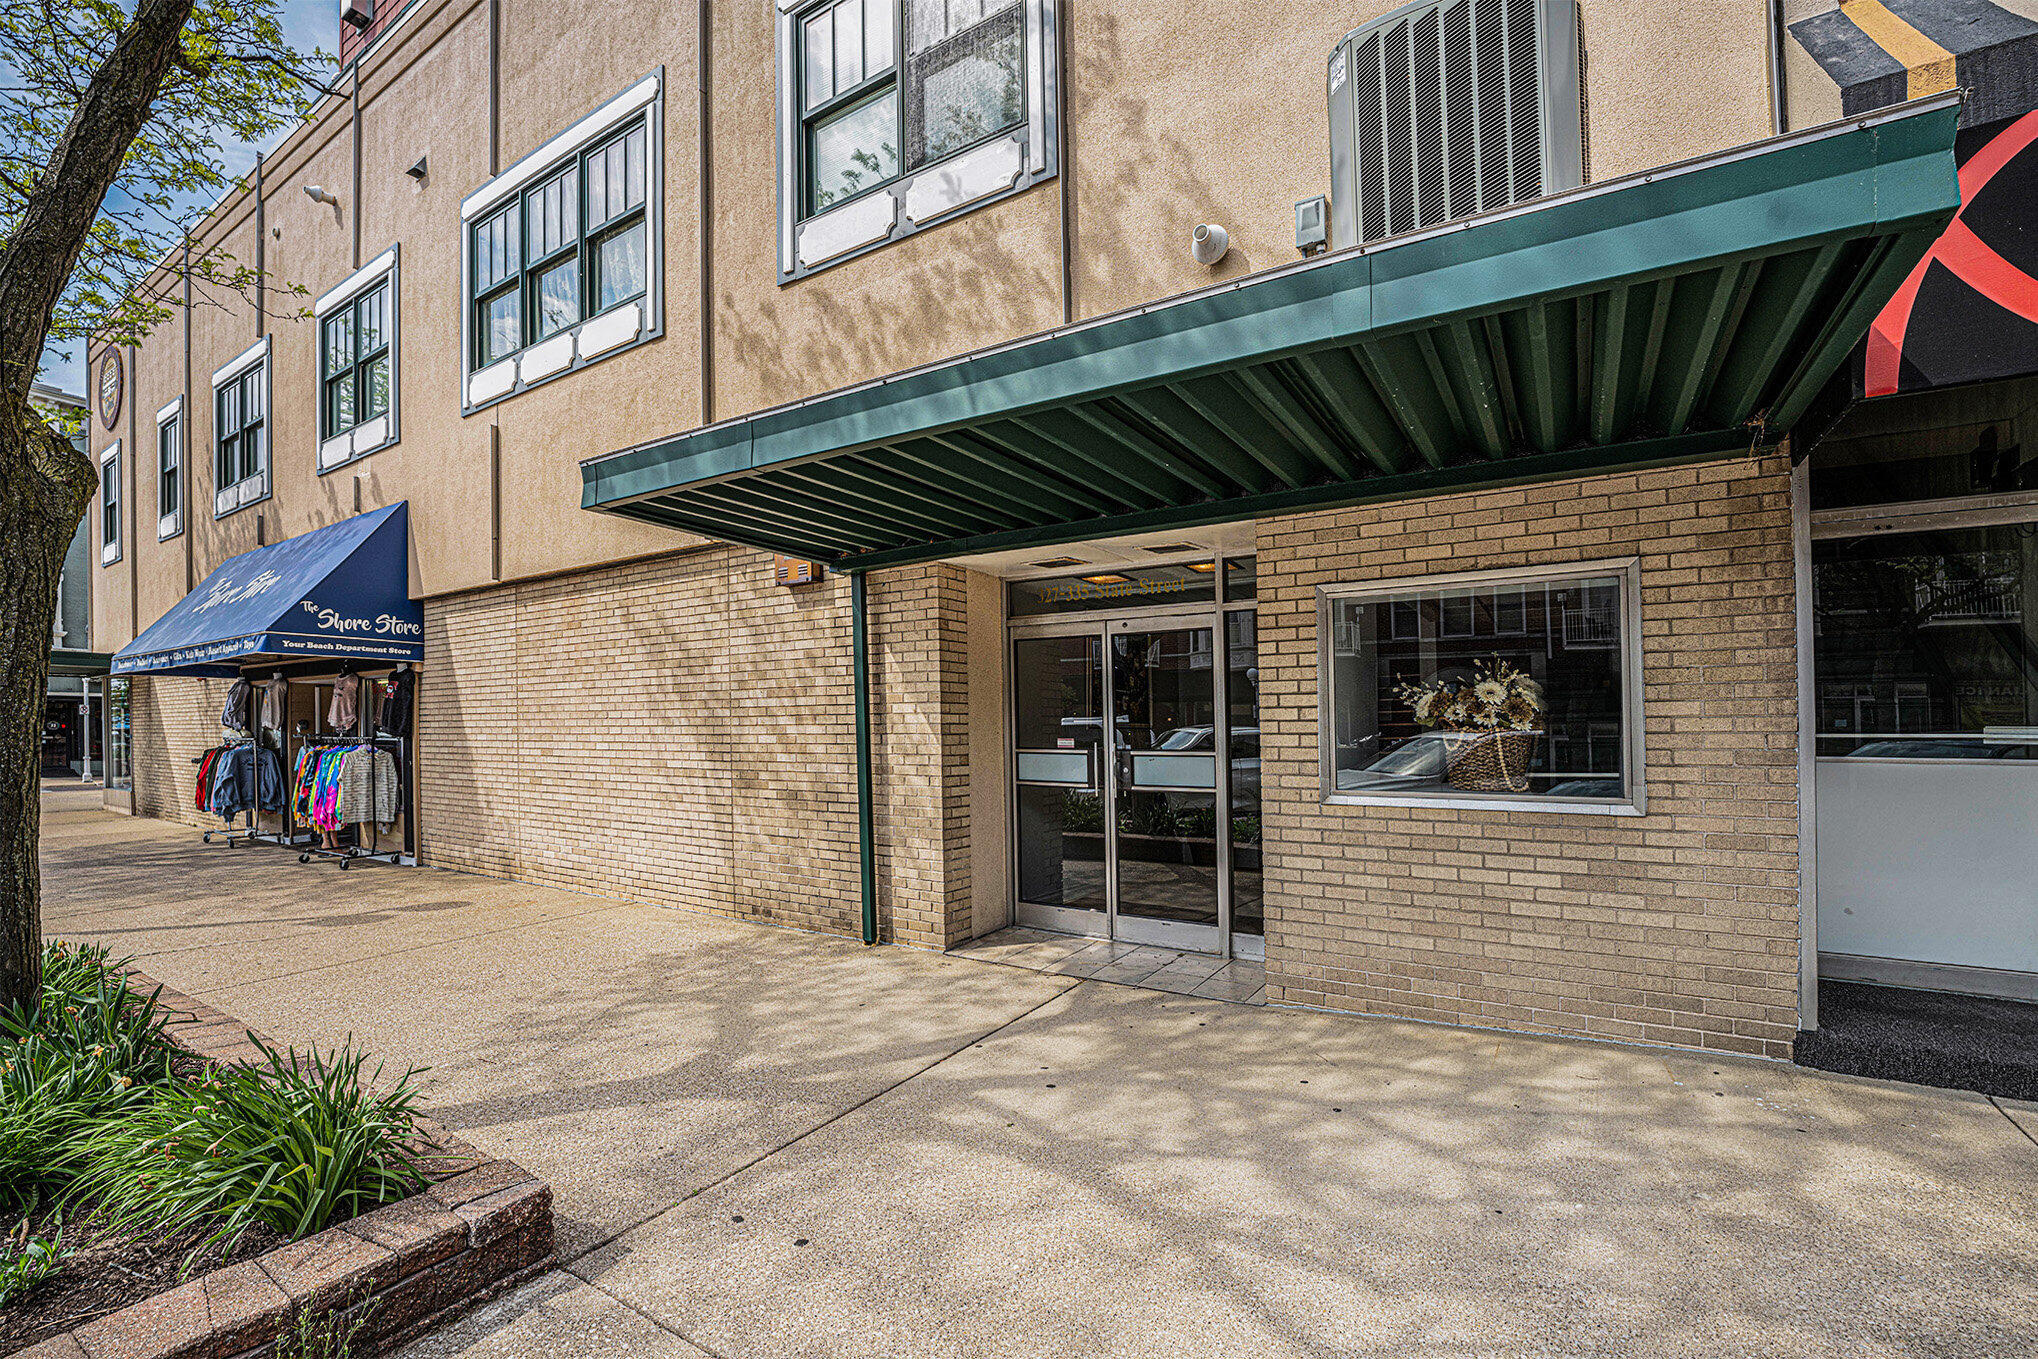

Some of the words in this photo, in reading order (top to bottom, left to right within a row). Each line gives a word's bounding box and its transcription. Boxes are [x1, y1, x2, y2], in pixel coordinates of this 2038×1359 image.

[1094, 583, 1133, 599] State
[1139, 577, 1186, 595] Street
[300, 600, 320, 614] The
[317, 608, 372, 633] Shore
[374, 613, 422, 635] Store
[282, 640, 306, 649] Your
[306, 641, 334, 650] Beach
[335, 643, 388, 654] Department
[388, 647, 412, 655] Store
